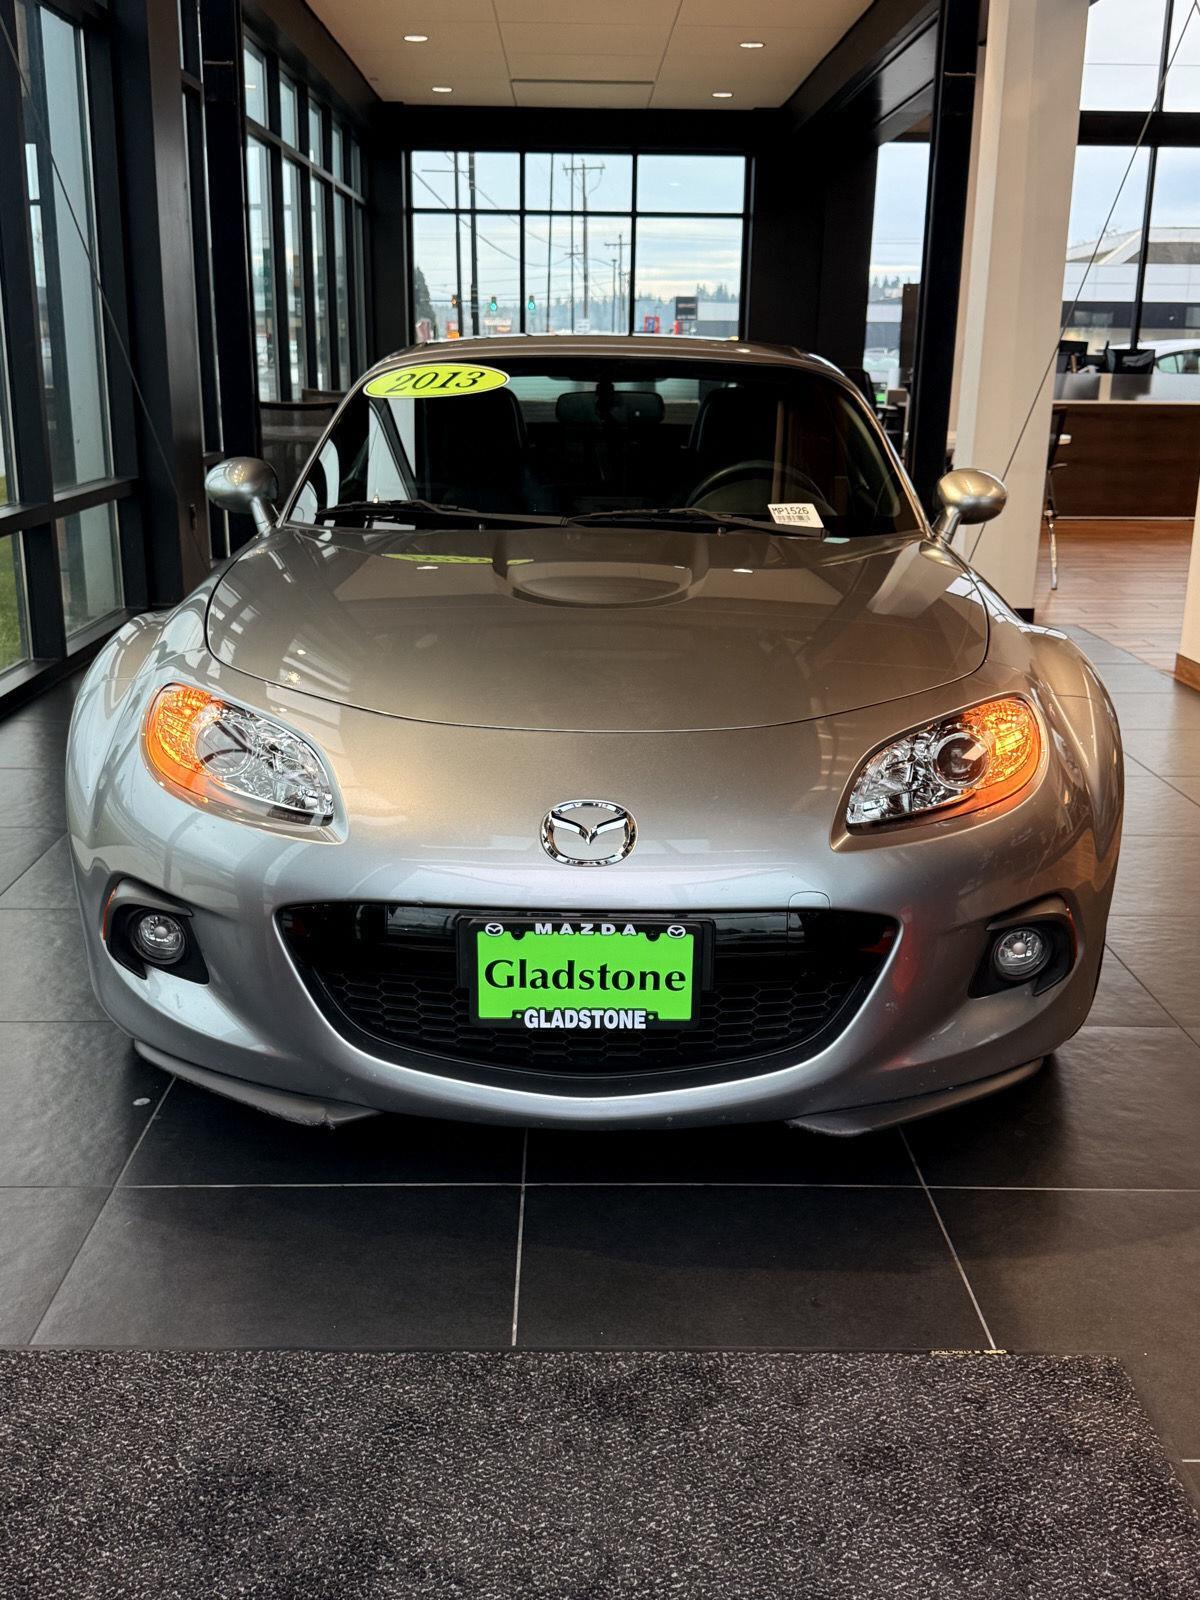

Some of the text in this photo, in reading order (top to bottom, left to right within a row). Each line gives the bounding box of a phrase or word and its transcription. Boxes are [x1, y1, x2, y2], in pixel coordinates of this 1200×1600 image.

[385, 371, 486, 394] 2013
[771, 506, 810, 516] MP1526
[534, 923, 637, 936] MAZDA
[484, 958, 686, 992] Gladstone
[523, 1009, 647, 1030] GLADSTONE
